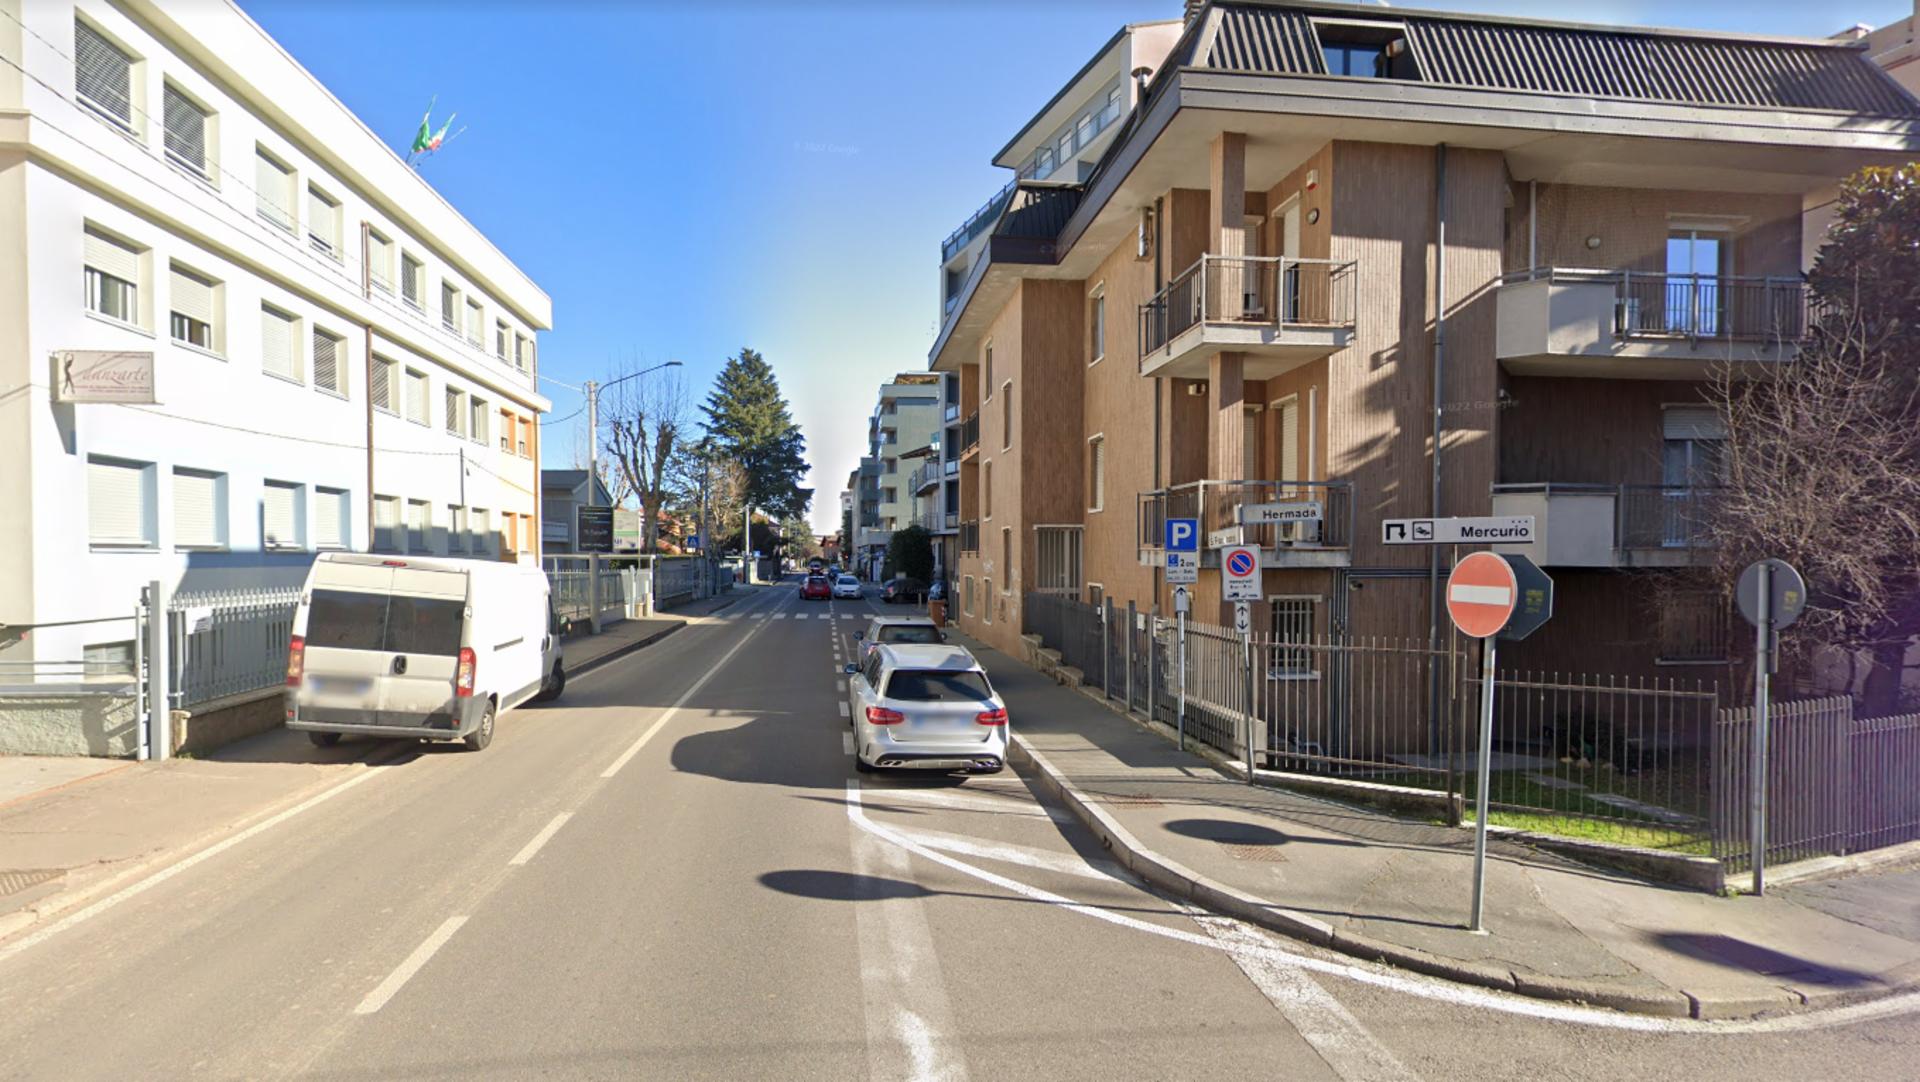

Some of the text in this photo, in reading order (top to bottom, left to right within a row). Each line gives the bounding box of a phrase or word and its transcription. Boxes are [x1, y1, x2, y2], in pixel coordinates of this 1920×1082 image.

[1262, 508, 1317, 519] Hermada
[1171, 522, 1192, 547] P
[1460, 525, 1529, 538] Mercurio
